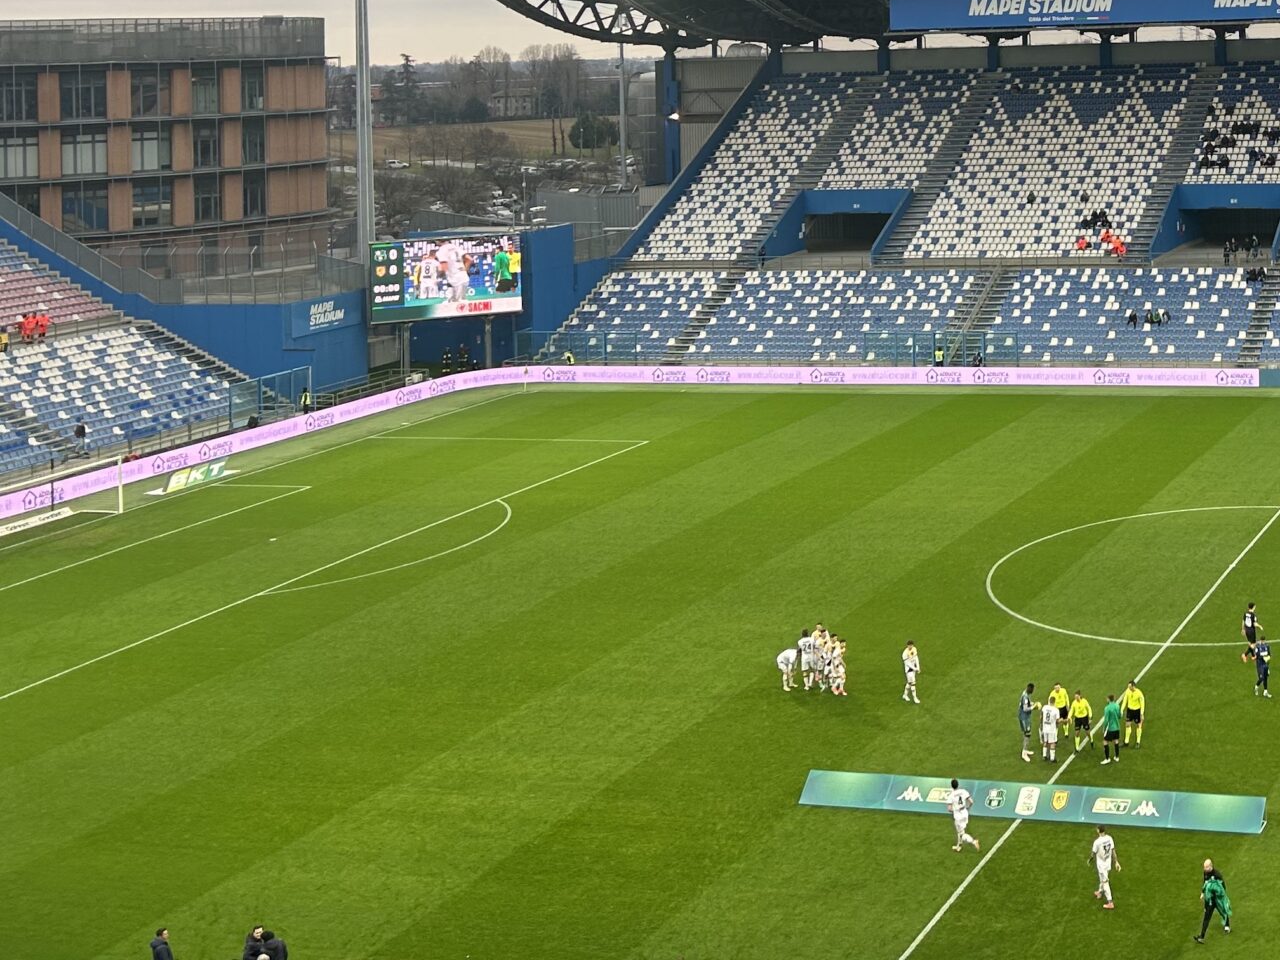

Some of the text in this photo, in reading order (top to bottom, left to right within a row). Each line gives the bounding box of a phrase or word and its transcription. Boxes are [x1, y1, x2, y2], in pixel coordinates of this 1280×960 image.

[310, 300, 334, 315] MAPEI
[468, 300, 492, 313] SACMI
[310, 309, 344, 326] STADIUM
[168, 461, 226, 491] BKT
[802, 643, 812, 652] 24
